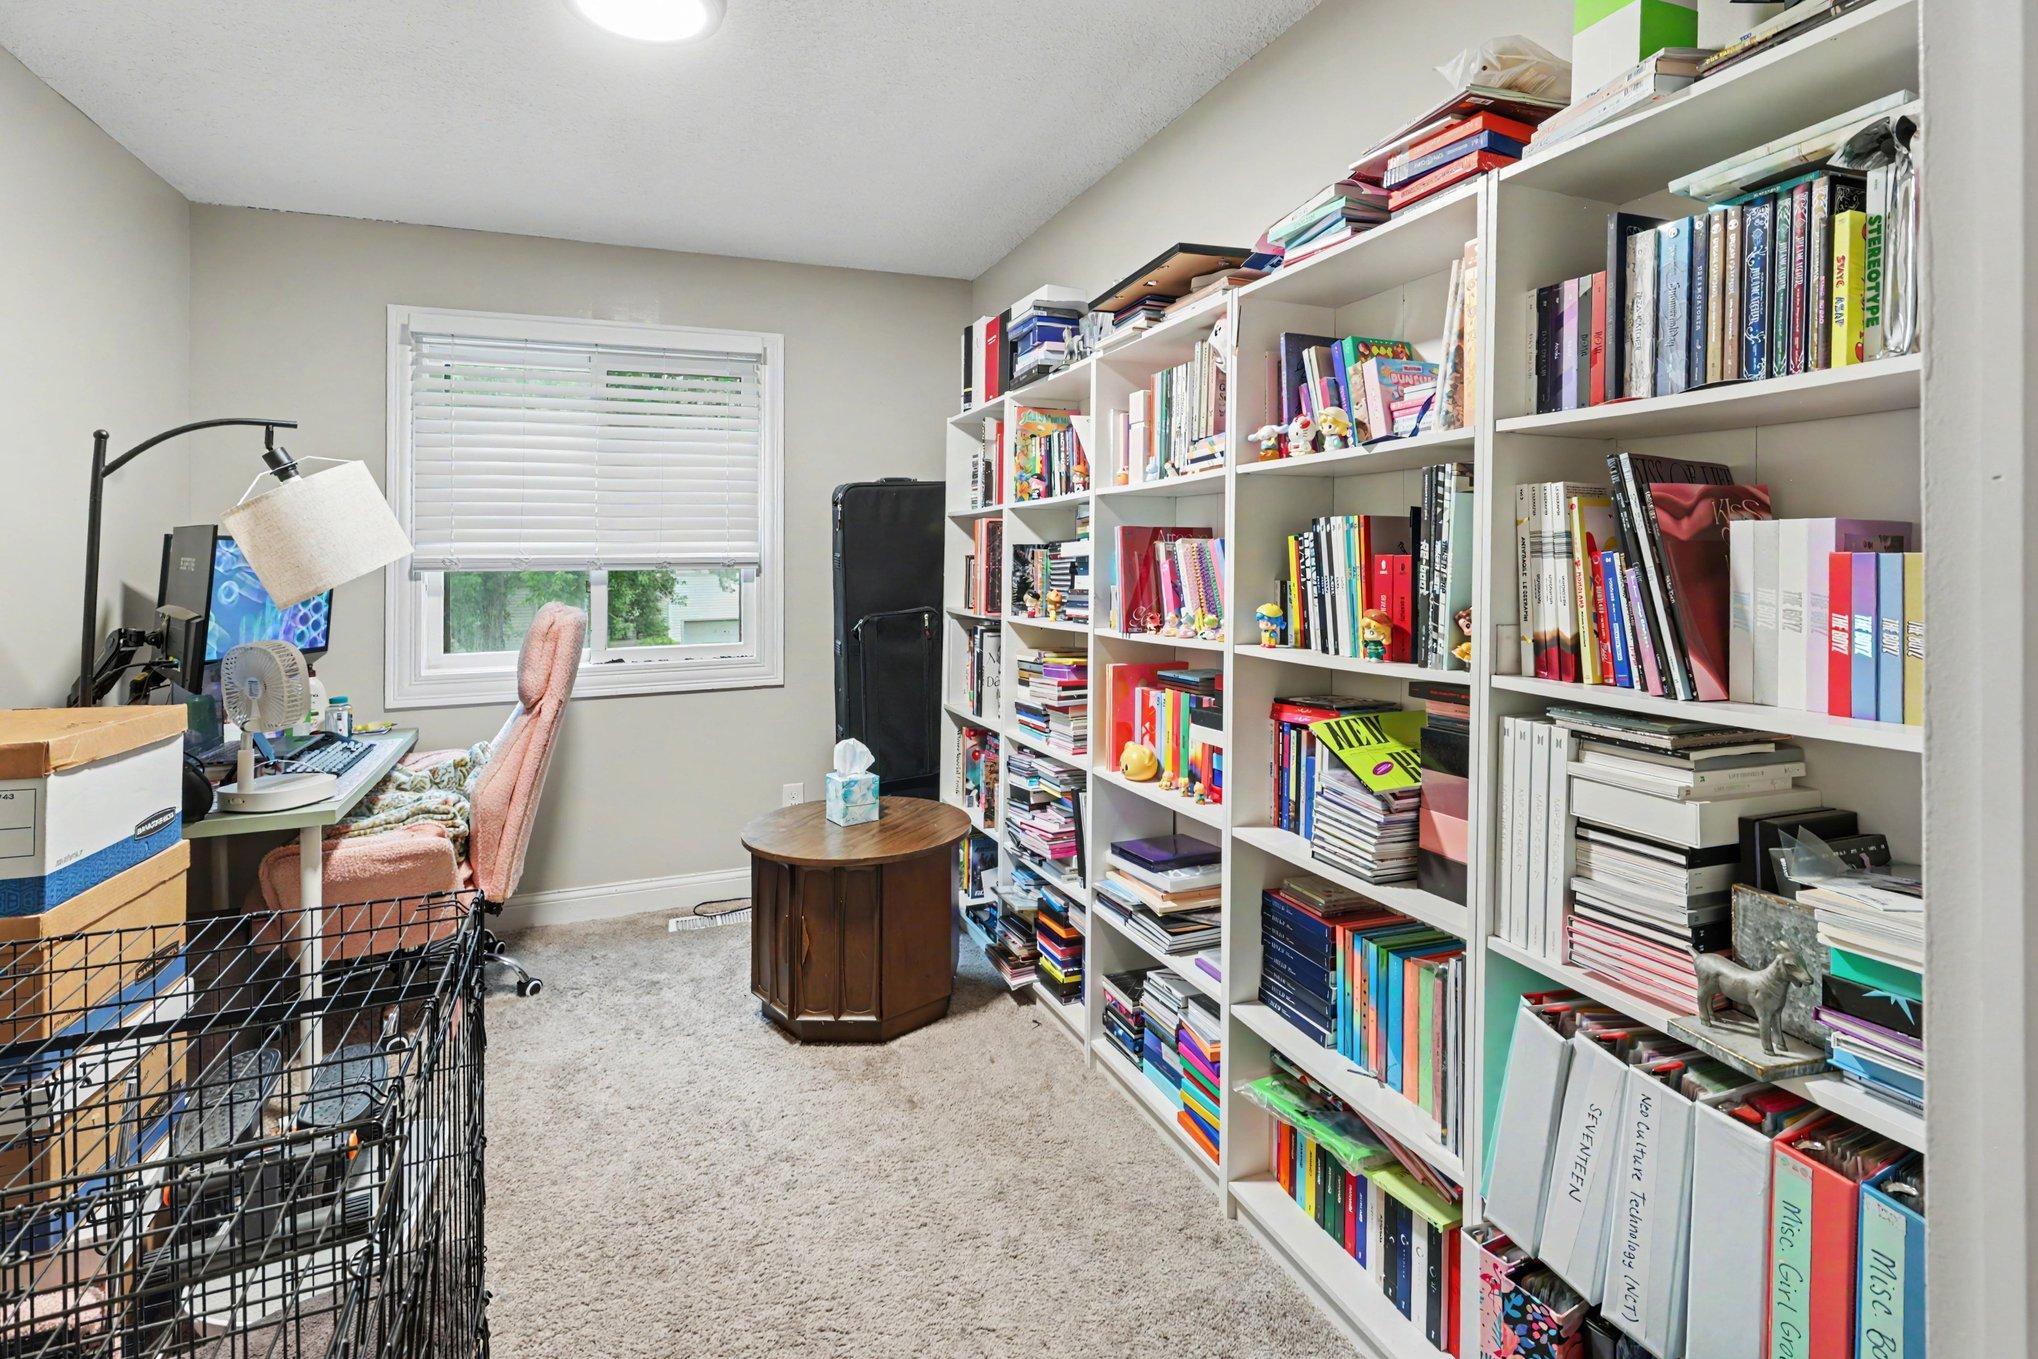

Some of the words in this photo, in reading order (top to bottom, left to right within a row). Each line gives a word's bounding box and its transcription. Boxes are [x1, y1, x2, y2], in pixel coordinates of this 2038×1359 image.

[1835, 254, 1847, 288] STAYC
[1865, 214, 1882, 328] STEREOTYPE
[1834, 296, 1845, 327] ASAP
[1782, 591, 1802, 608] THE
[1782, 608, 1802, 634] BOYZ
[1831, 613, 1849, 631] THE
[1854, 615, 1873, 632] THE
[1882, 618, 1900, 635] THE
[1906, 621, 1924, 638] THE
[1831, 630, 1849, 655] BOYZ
[1854, 631, 1873, 658] BOYZ
[1882, 633, 1900, 657] BOYZ
[1906, 636, 1924, 660] BOYZ
[1324, 715, 1390, 751] NEW
[1567, 1103, 1603, 1203] SEVENTEEN
[1631, 1121, 1651, 1182] Culture
[1622, 1190, 1648, 1269] Technology
[1780, 1199, 1804, 1252] Misc.
[1777, 1262, 1804, 1313] Girl
[1869, 1248, 1898, 1317] Misc.
[1620, 1274, 1641, 1324] (NCT)
